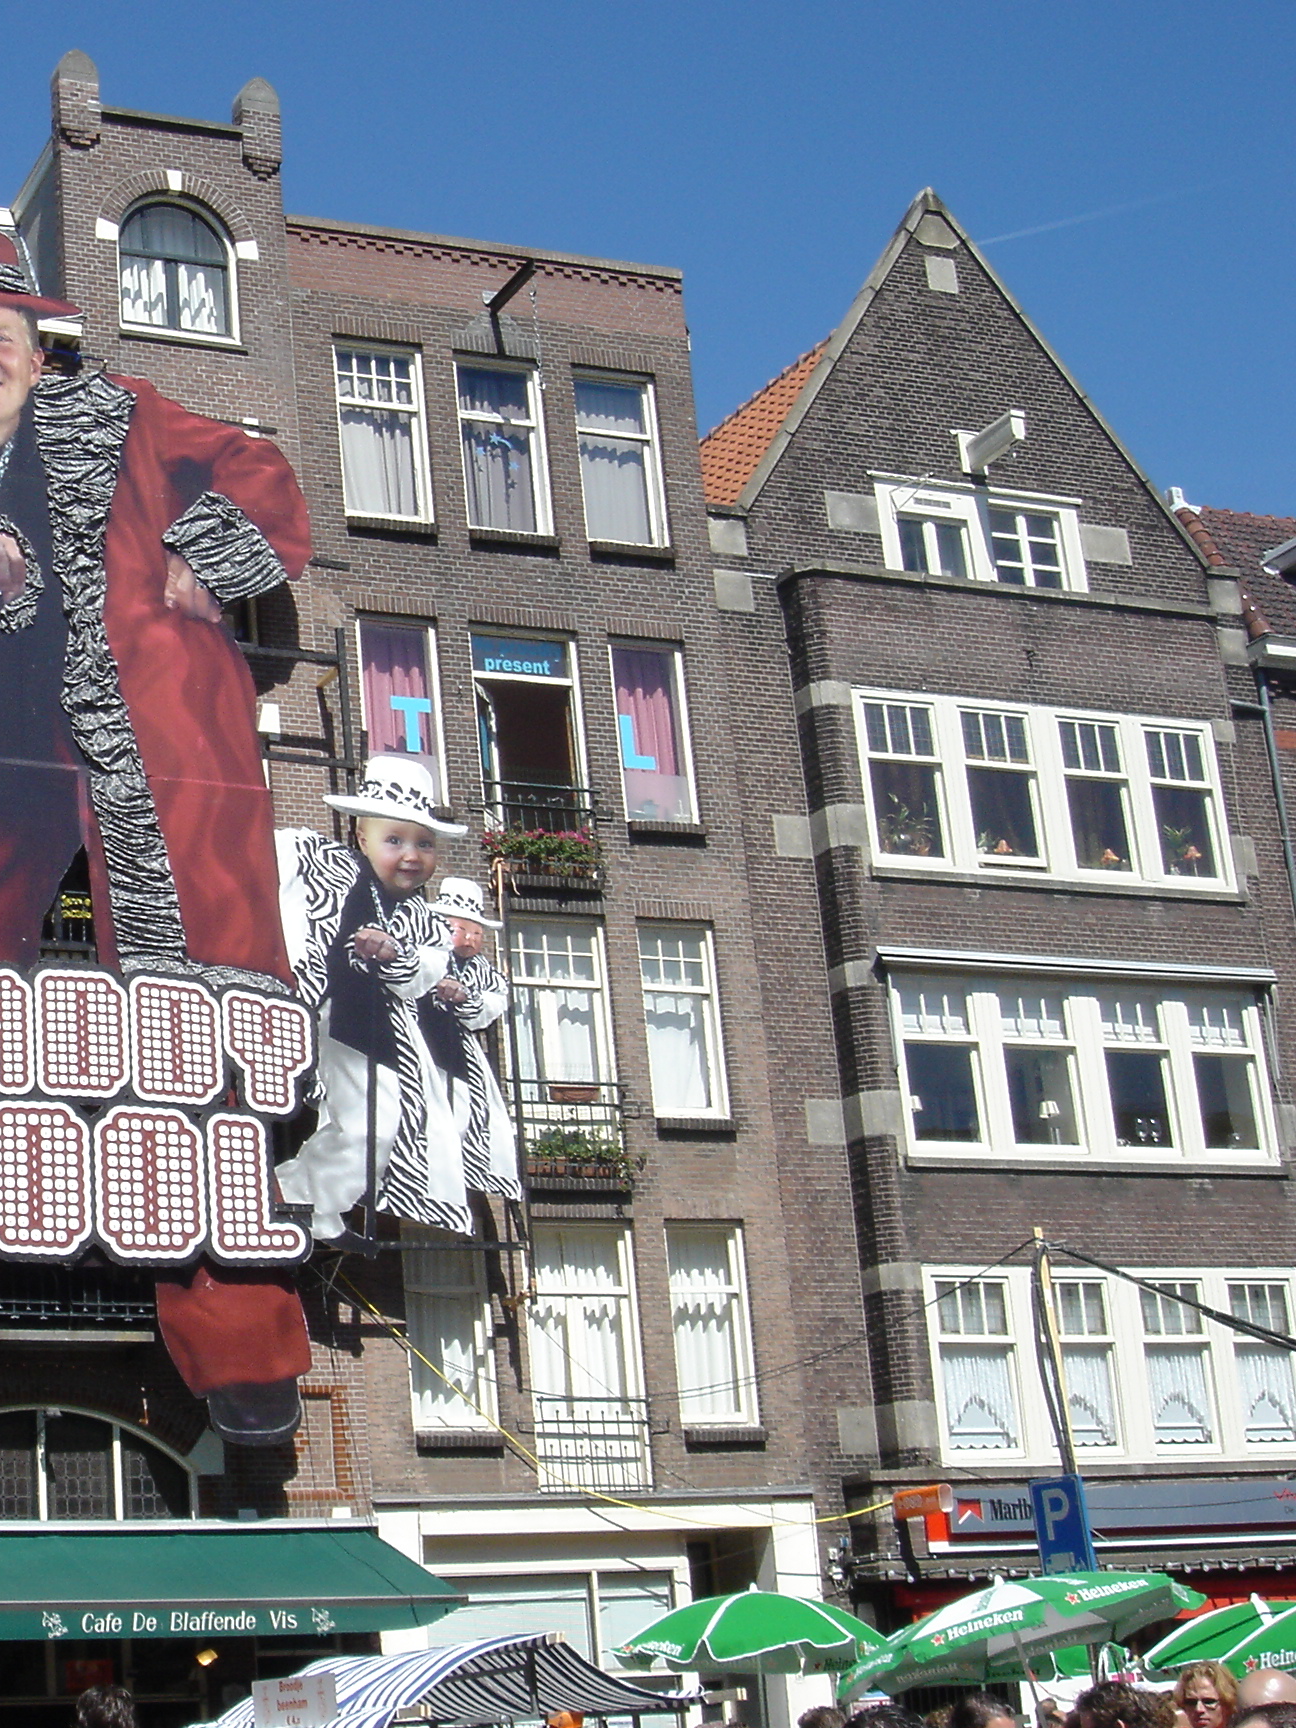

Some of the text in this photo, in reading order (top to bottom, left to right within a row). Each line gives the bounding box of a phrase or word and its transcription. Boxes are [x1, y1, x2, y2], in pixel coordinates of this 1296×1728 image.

[484, 657, 551, 675] present
[990, 1498, 1032, 1521] Marlb
[1041, 1488, 1070, 1541] P
[1077, 1578, 1149, 1602] Heineken
[81, 1609, 298, 1633] Cafe De Blaffende Vis
[946, 1608, 1024, 1641] Heineken
[1260, 1649, 1296, 1670] Hein
